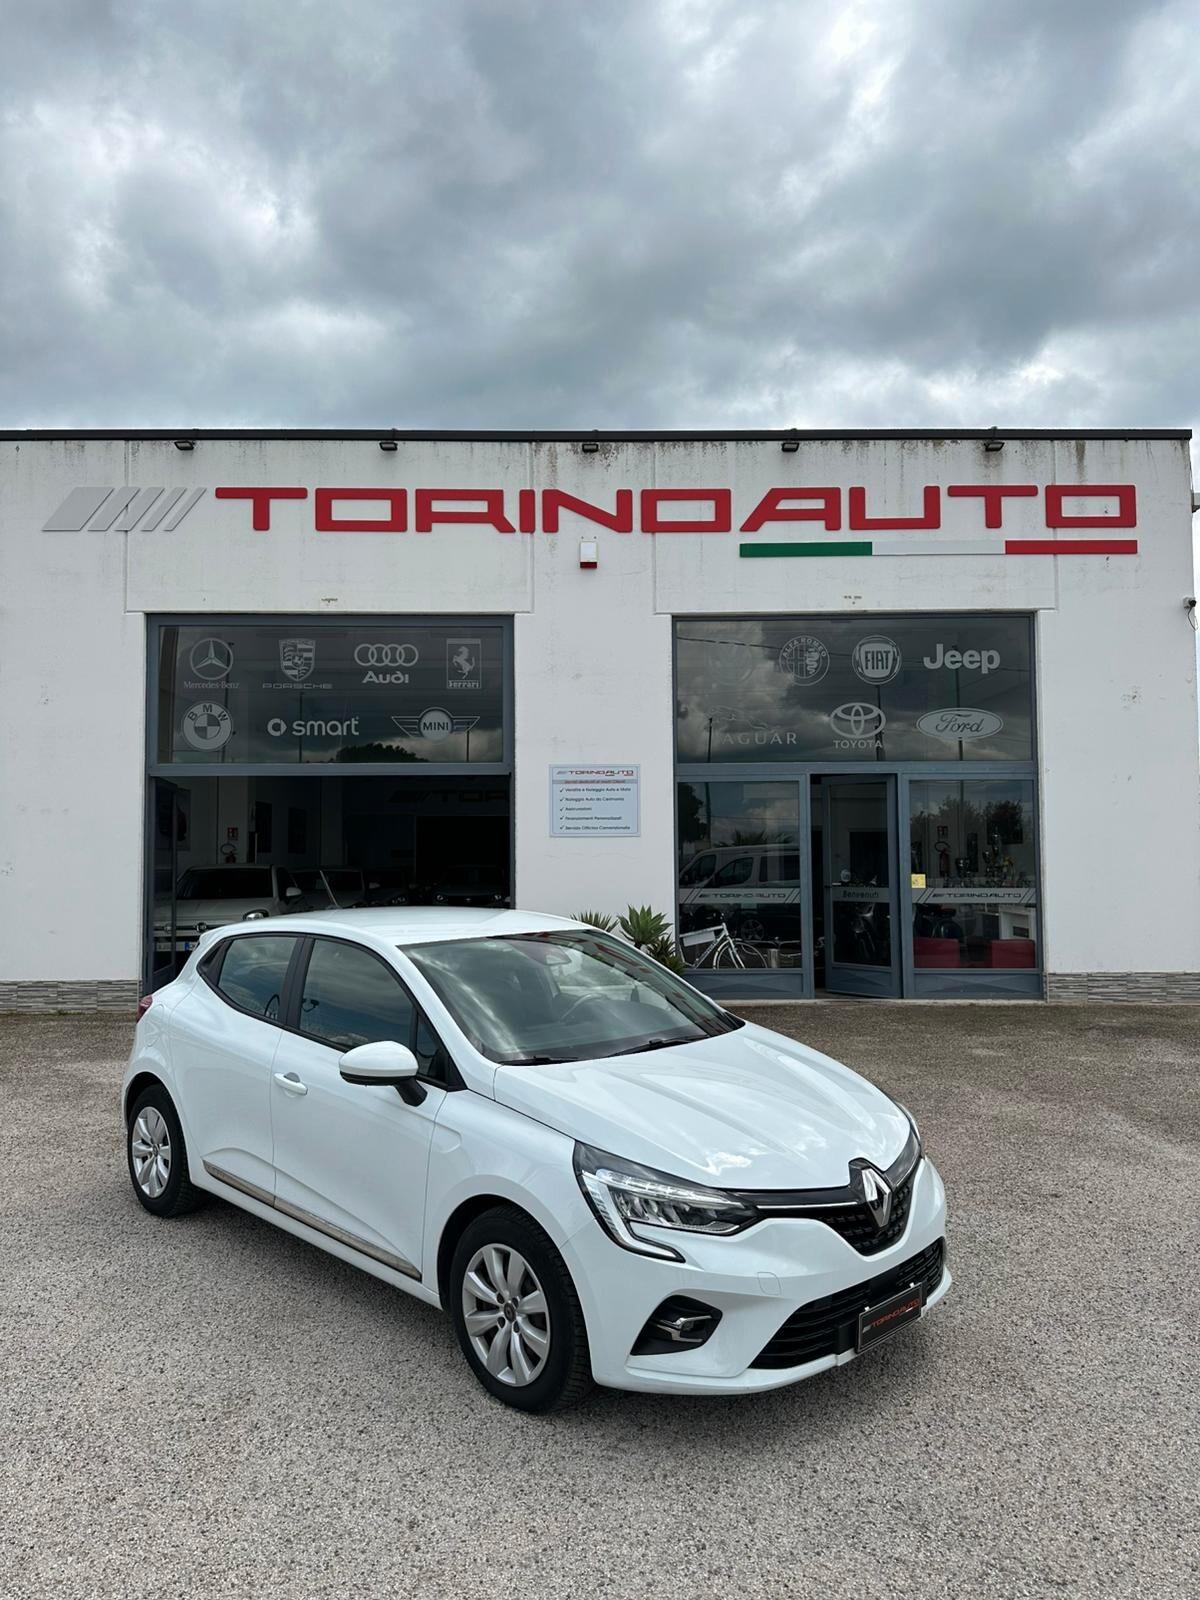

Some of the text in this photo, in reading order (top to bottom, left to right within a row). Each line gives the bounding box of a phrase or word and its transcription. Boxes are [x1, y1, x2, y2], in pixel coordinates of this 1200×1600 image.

[215, 484, 1137, 533] TORINOAUTO
[782, 637, 827, 658] ALFA ROMEO
[864, 650, 891, 670] FIAT
[923, 643, 1001, 674] Jeep
[183, 680, 240, 689] Mercedes-Benz
[362, 670, 409, 684] Audi
[448, 679, 479, 689] Ferrari
[187, 704, 229, 722] BMW
[292, 718, 359, 736] smart
[422, 722, 449, 731] MINI
[935, 713, 985, 733] Ford
[714, 732, 798, 745] AGUAR
[833, 740, 883, 749] TOYOTA
